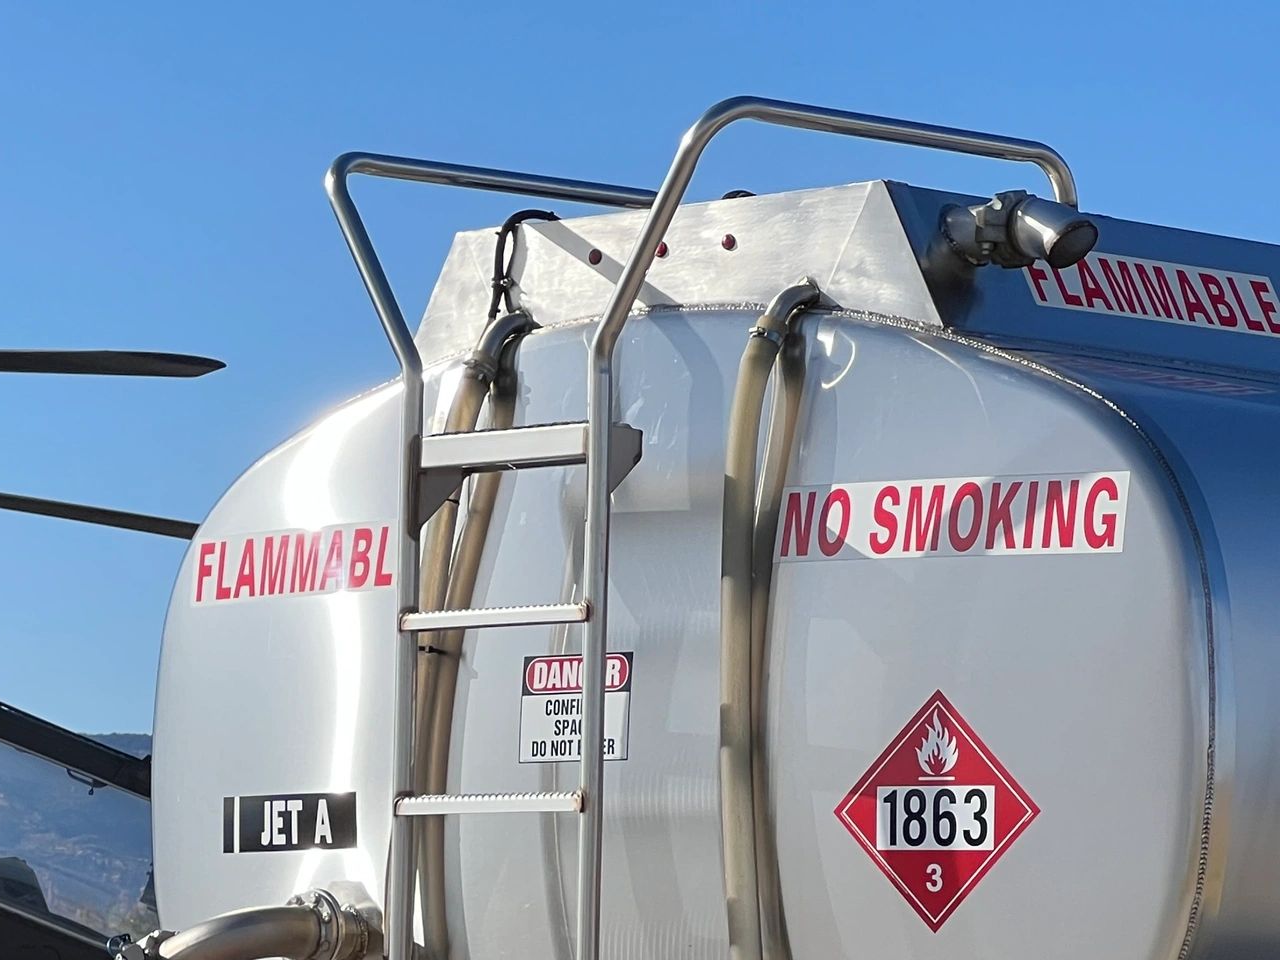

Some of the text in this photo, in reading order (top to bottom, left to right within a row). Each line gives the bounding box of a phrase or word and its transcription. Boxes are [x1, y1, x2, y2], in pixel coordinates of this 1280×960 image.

[1027, 257, 1280, 335] FLAMMABLE
[780, 477, 1119, 557] NO SMOKING
[195, 526, 393, 602] FLAMMABL
[533, 659, 621, 689] DANR
[545, 699, 583, 716] CONFI
[554, 719, 582, 736] SPA
[532, 740, 547, 757] DO
[551, 739, 574, 756] NOT
[261, 798, 333, 846] JET A
[883, 788, 988, 847] 1863
[925, 863, 943, 893] 3
